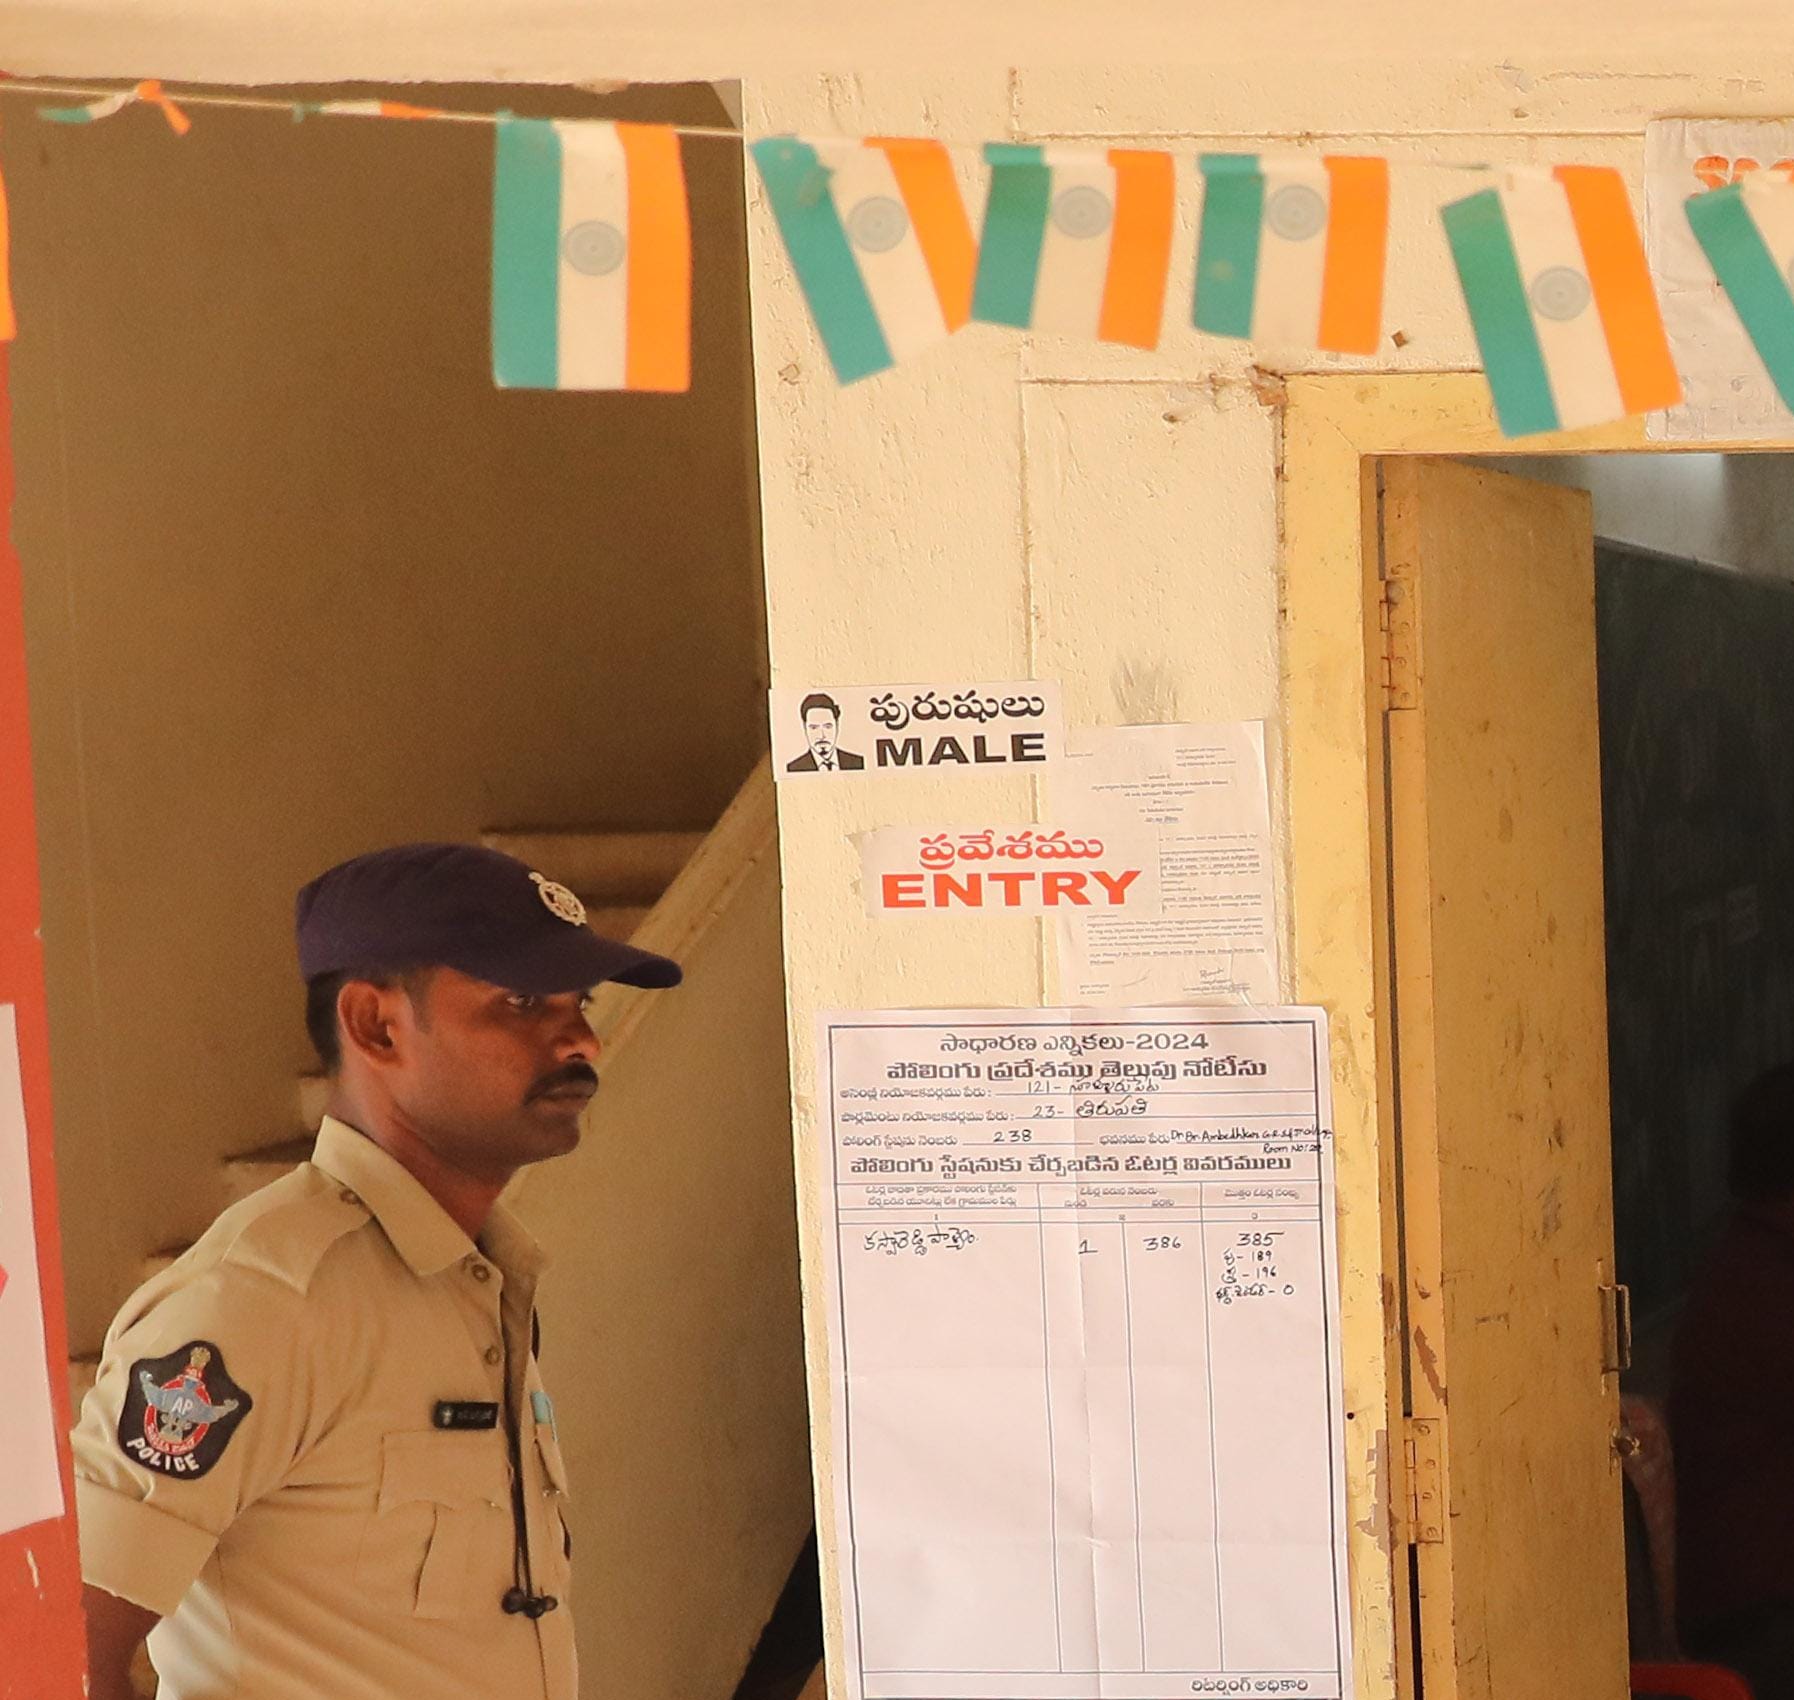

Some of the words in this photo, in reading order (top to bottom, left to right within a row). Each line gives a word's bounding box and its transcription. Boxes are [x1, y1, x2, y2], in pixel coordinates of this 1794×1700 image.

[869, 690, 1046, 731] పురుషులు
[875, 732, 1047, 768] MALE
[917, 829, 1105, 871] ప్రవేశము
[880, 869, 1142, 909] ENTRY
[940, 1033, 1037, 1054] సాధారణ
[887, 1062, 980, 1079] పోలింగు
[992, 1129, 1032, 1143] 238
[1143, 1236, 1182, 1251] 386
[1251, 1252, 1272, 1262] 189
[171, 1397, 193, 1415] AP
[126, 1437, 199, 1472] POLICE
